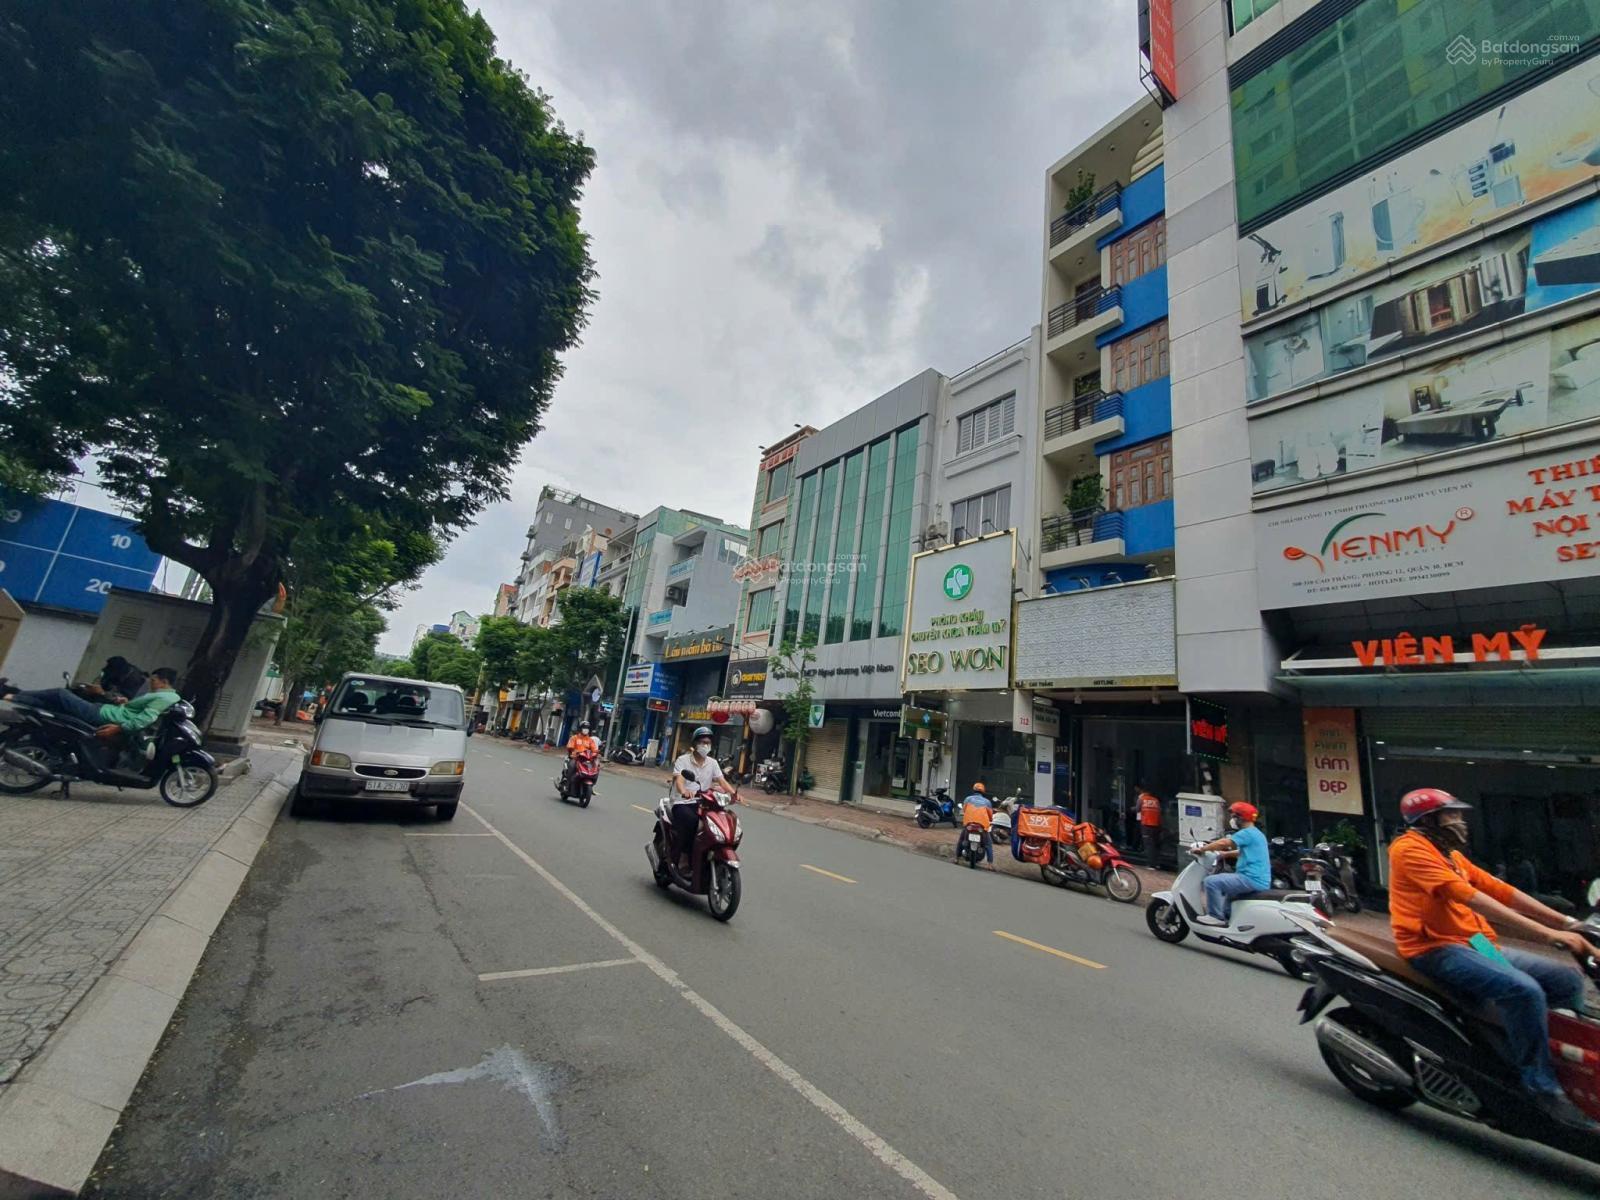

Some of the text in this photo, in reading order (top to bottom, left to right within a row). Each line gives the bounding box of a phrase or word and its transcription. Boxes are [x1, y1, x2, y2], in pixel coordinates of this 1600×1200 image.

[1506, 488, 1577, 515] MÁY
[1533, 514, 1591, 538] NỘI
[111, 534, 132, 550] 10
[85, 578, 112, 595] 20
[931, 608, 984, 626] PHÒNG KHÁM
[911, 628, 940, 642] CHUYÊN
[942, 627, 965, 640] KHOA
[1352, 623, 1547, 667] VIÊN MỸ
[876, 664, 895, 673] Nam
[908, 645, 1007, 675] SEO WON
[1314, 754, 1350, 771] LÀM
[1319, 779, 1348, 796] ĐẸP
[1142, 800, 1157, 808] SPX
[1029, 815, 1050, 826] SPX
